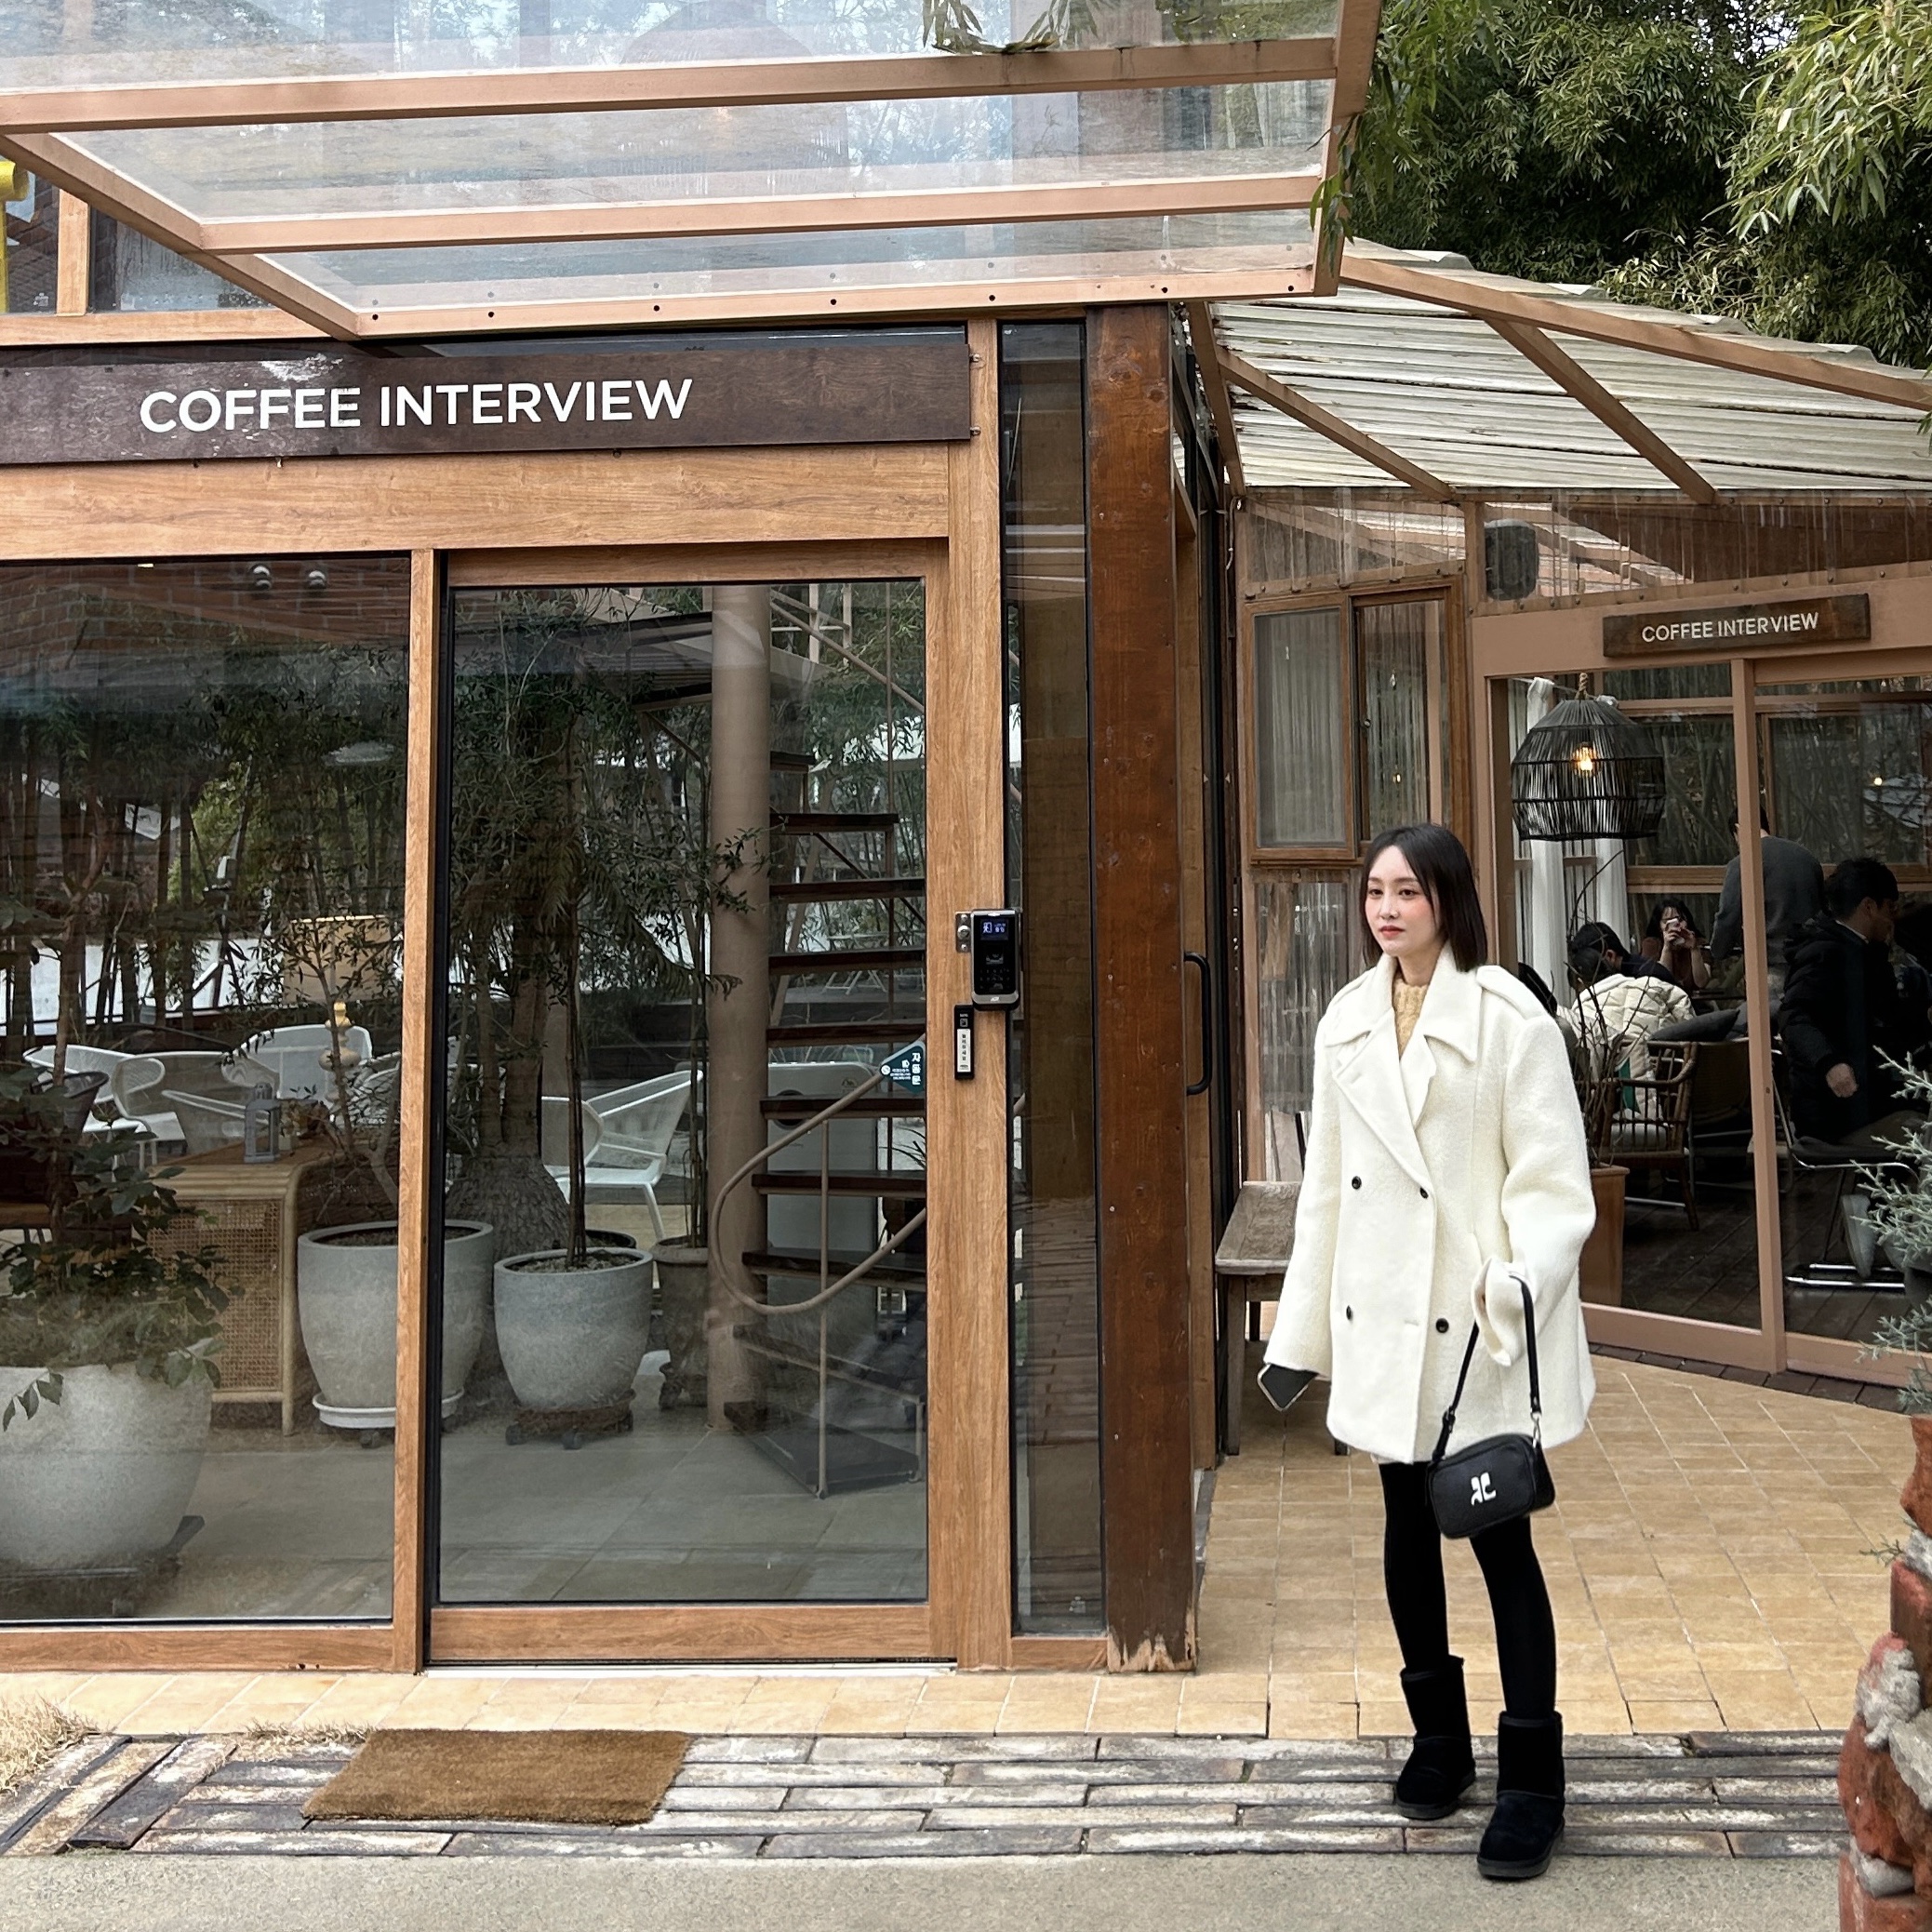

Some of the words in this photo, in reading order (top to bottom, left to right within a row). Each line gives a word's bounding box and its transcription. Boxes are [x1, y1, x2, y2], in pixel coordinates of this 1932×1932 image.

[139, 386, 361, 433] COFFEE
[380, 378, 693, 428] INTERVIEW
[1641, 621, 1713, 644] COFFEE
[1717, 611, 1819, 637] INTERVIEW
